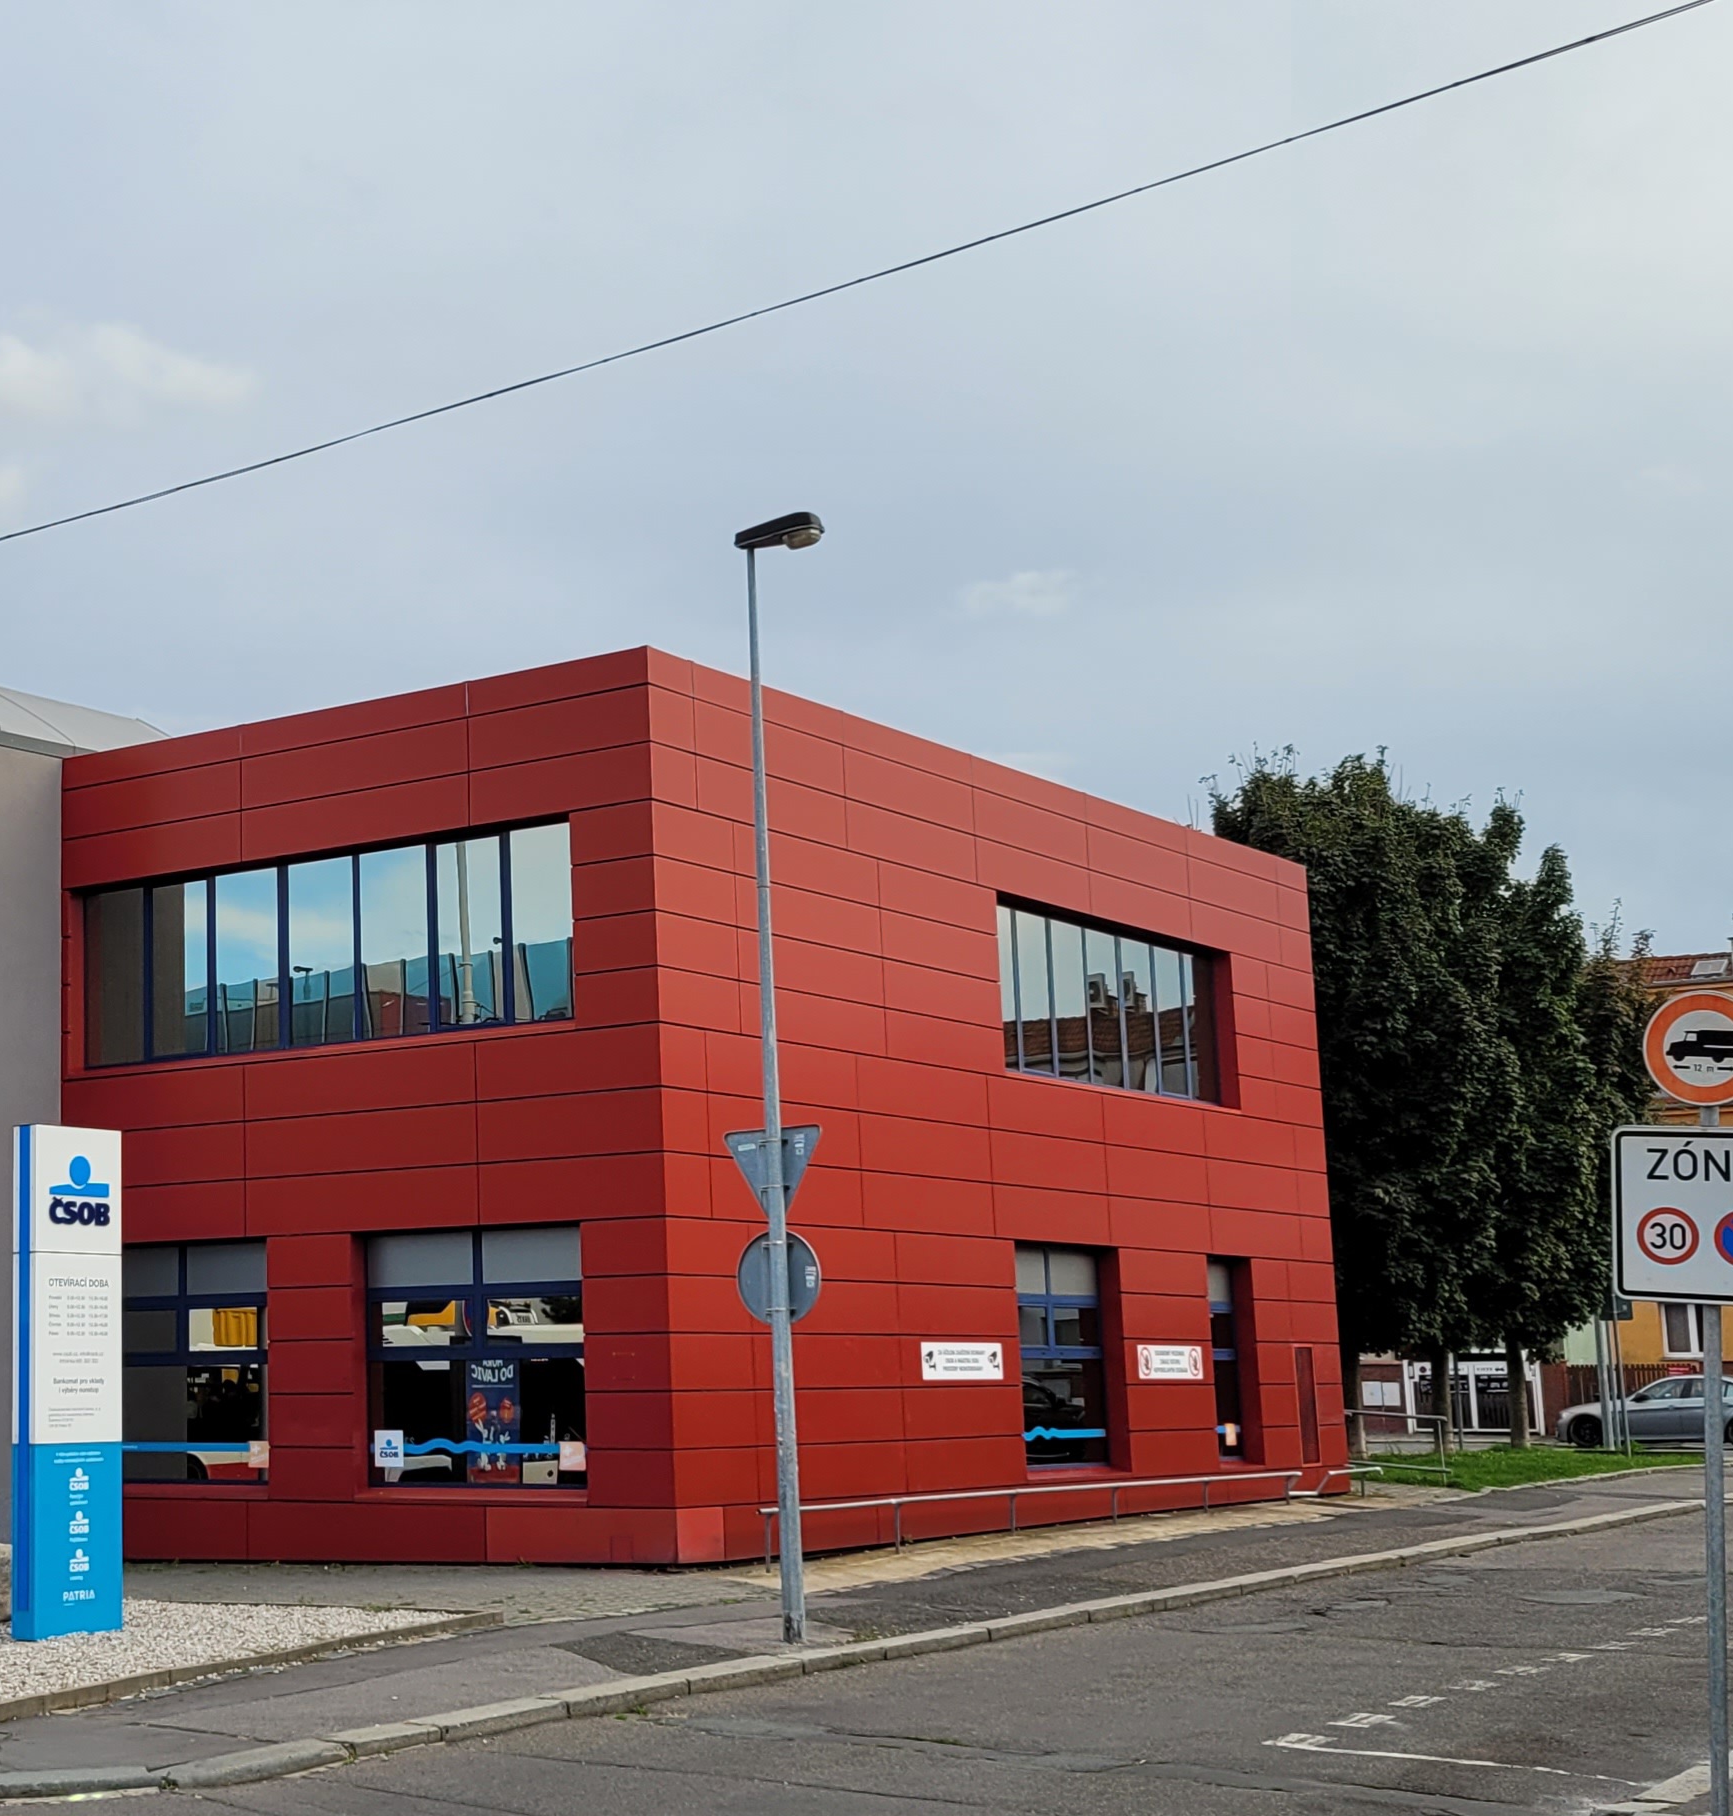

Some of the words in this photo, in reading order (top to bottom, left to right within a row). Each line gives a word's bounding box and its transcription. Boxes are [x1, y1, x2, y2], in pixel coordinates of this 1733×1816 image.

[1693, 1063, 1703, 1072] 12
[1706, 1065, 1714, 1073] m
[1646, 1140, 1731, 1182] ZÓN
[48, 1196, 111, 1227] ČSOB
[1649, 1221, 1687, 1250] 30
[48, 1276, 88, 1288] OTEVÍRACÍ
[88, 1278, 110, 1288] DOBA
[379, 1450, 399, 1459] ČSOB
[62, 1589, 96, 1602] PATRIA
